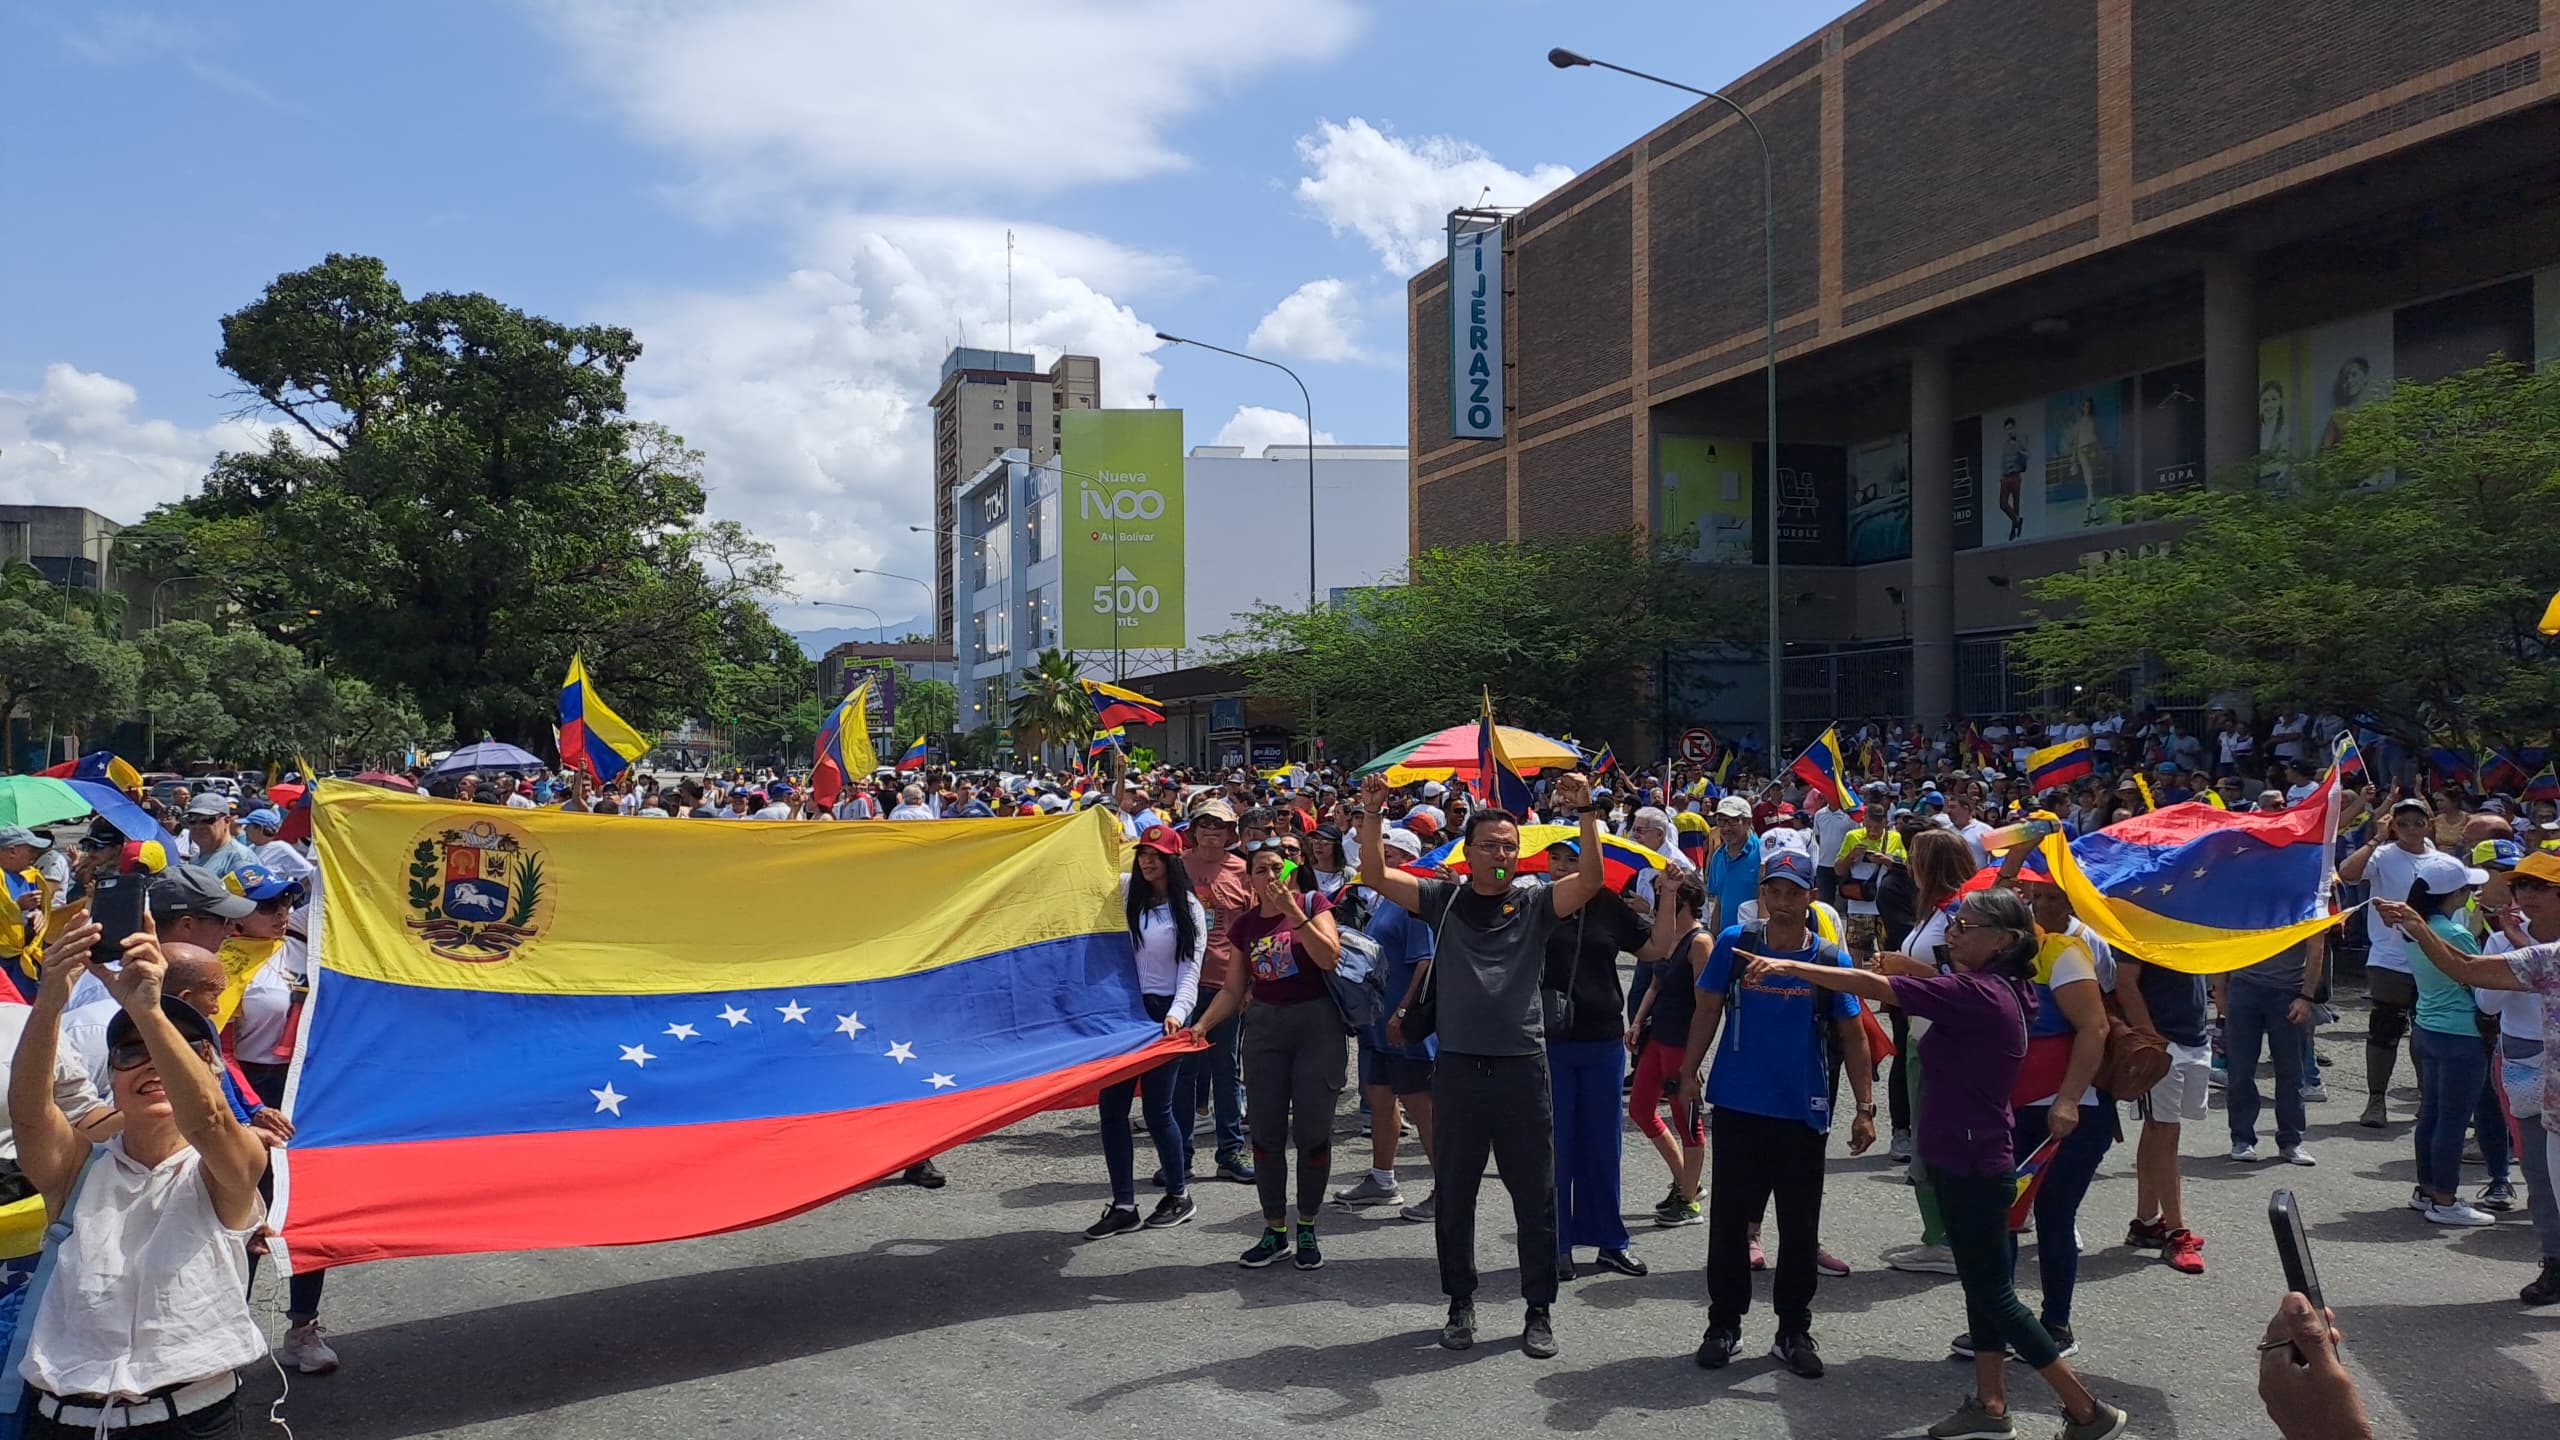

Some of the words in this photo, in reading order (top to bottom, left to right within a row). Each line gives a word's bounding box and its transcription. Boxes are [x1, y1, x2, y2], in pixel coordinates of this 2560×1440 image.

[1098, 470, 1147, 482] Nueva
[2160, 469, 2194, 484] ROPA
[1120, 531, 1155, 542] Bolívar
[1093, 585, 1160, 613] 500
